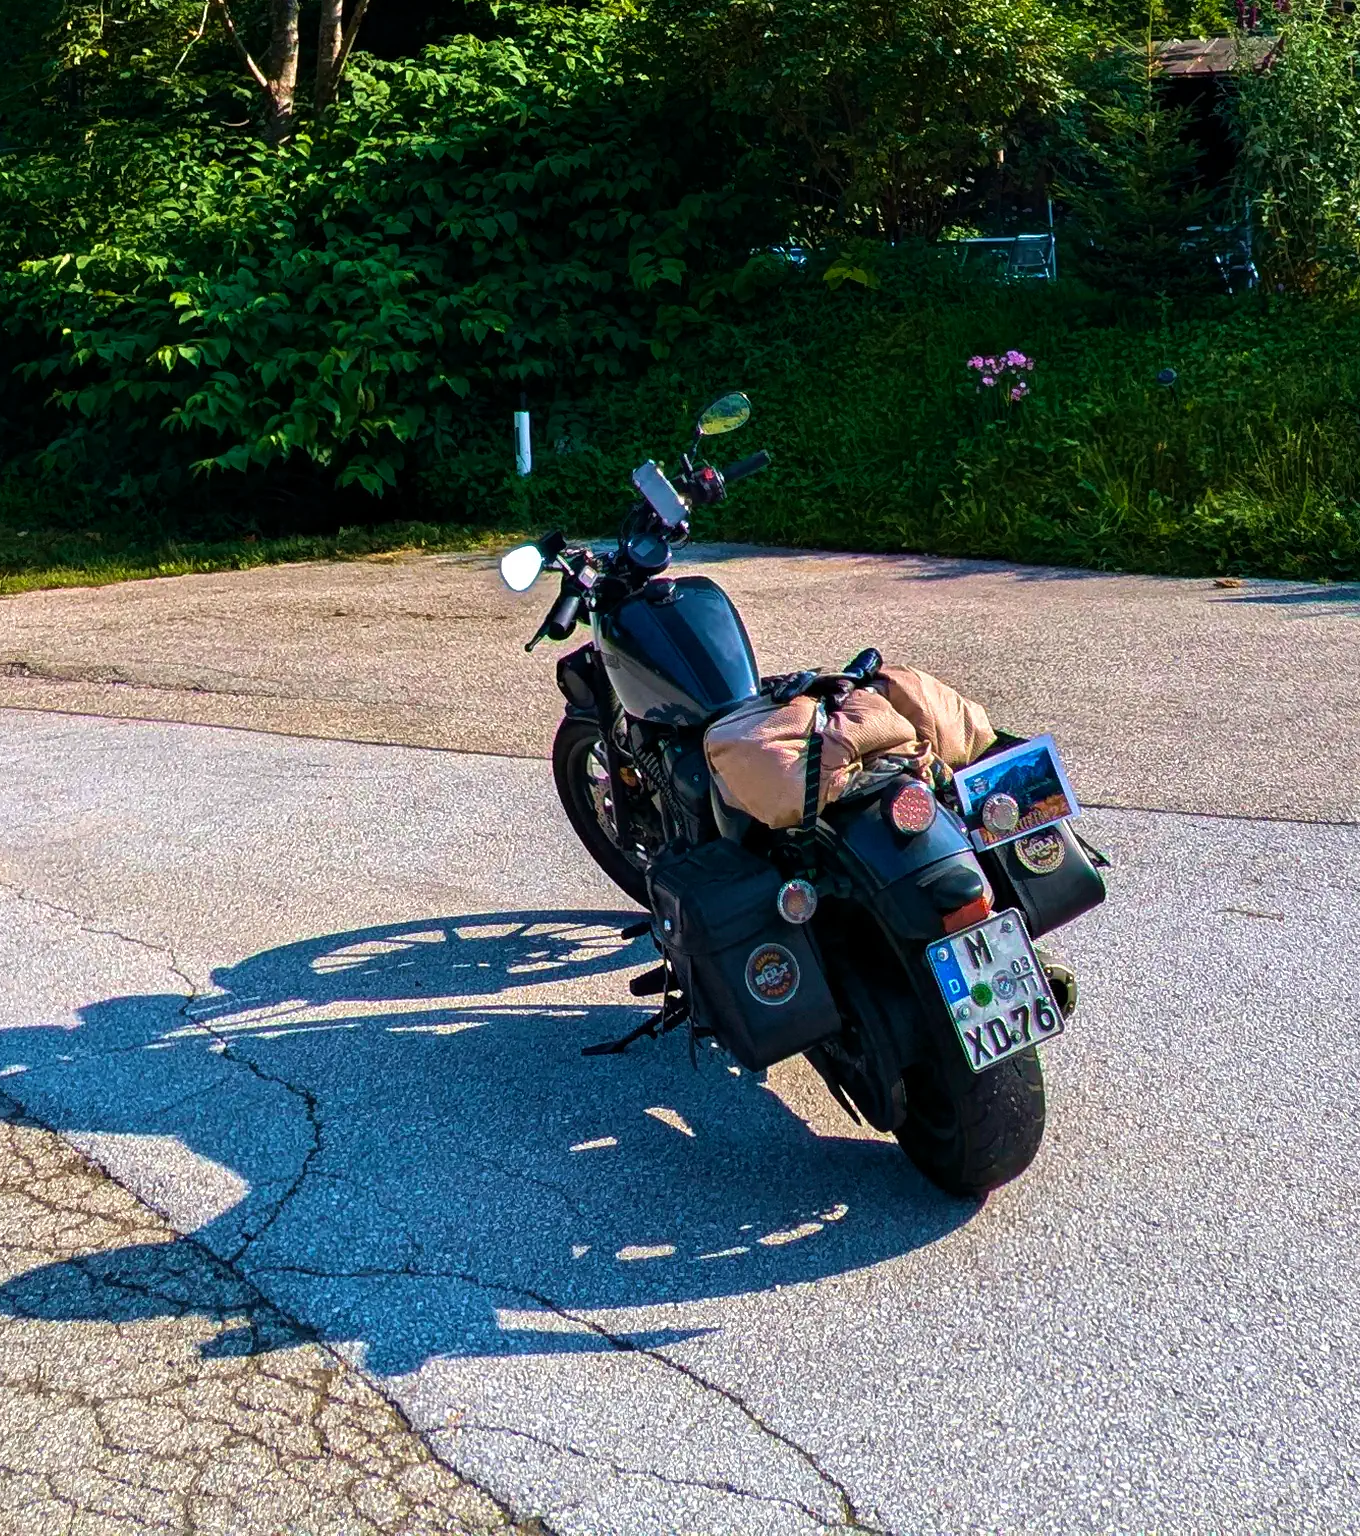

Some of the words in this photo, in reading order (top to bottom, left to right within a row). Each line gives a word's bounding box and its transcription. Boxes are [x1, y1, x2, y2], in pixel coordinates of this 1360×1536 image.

[963, 928, 995, 969] M
[1010, 955, 1032, 975] 03
[948, 978, 961, 994] D
[964, 1016, 1013, 1065] XD
[1011, 998, 1056, 1042] 76
